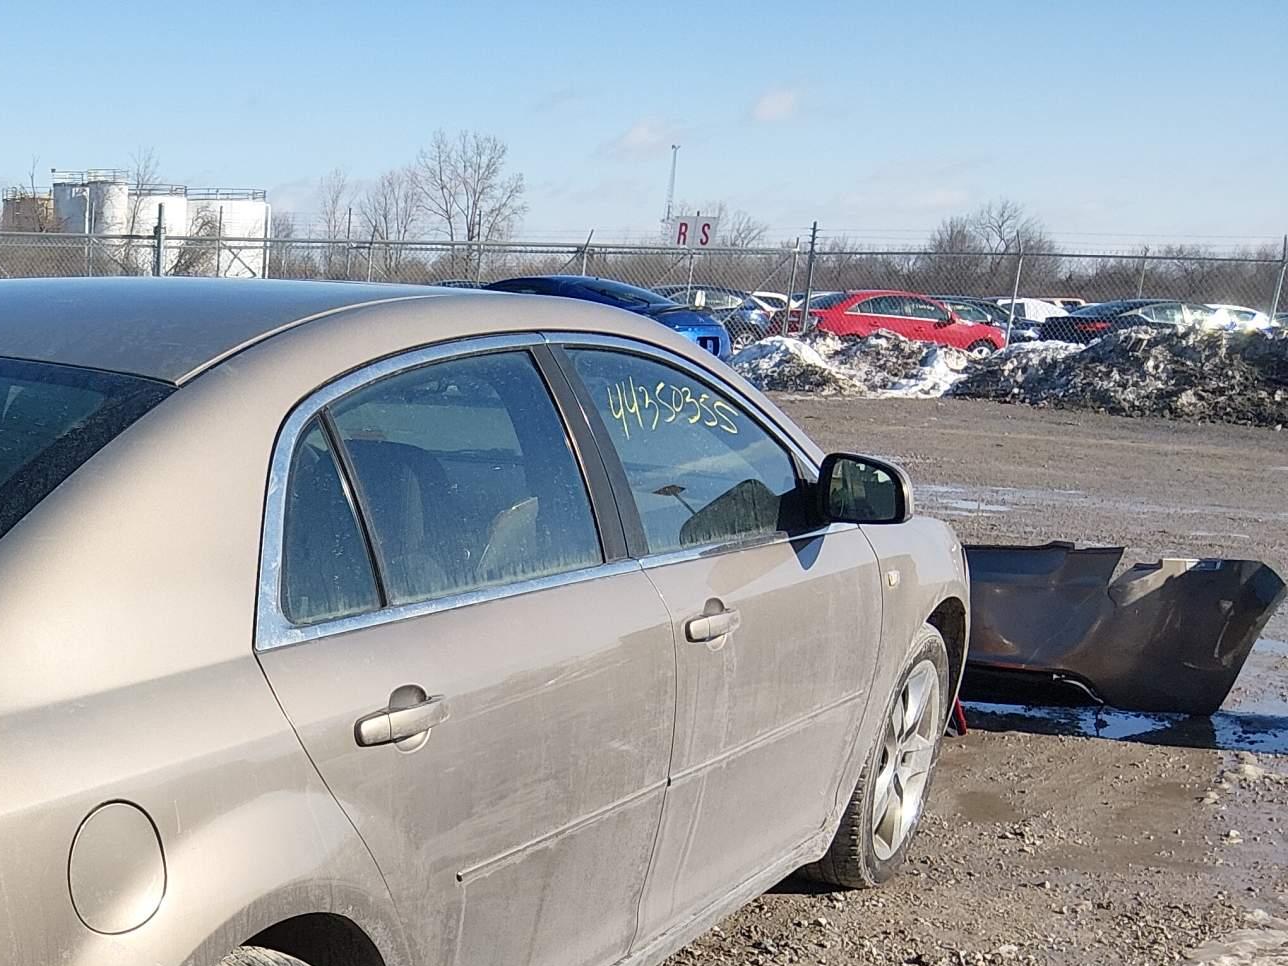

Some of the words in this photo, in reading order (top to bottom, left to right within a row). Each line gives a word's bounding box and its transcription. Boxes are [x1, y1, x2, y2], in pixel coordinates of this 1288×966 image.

[677, 222, 688, 245] R
[700, 223, 711, 246] S
[607, 375, 739, 440] 44350355
